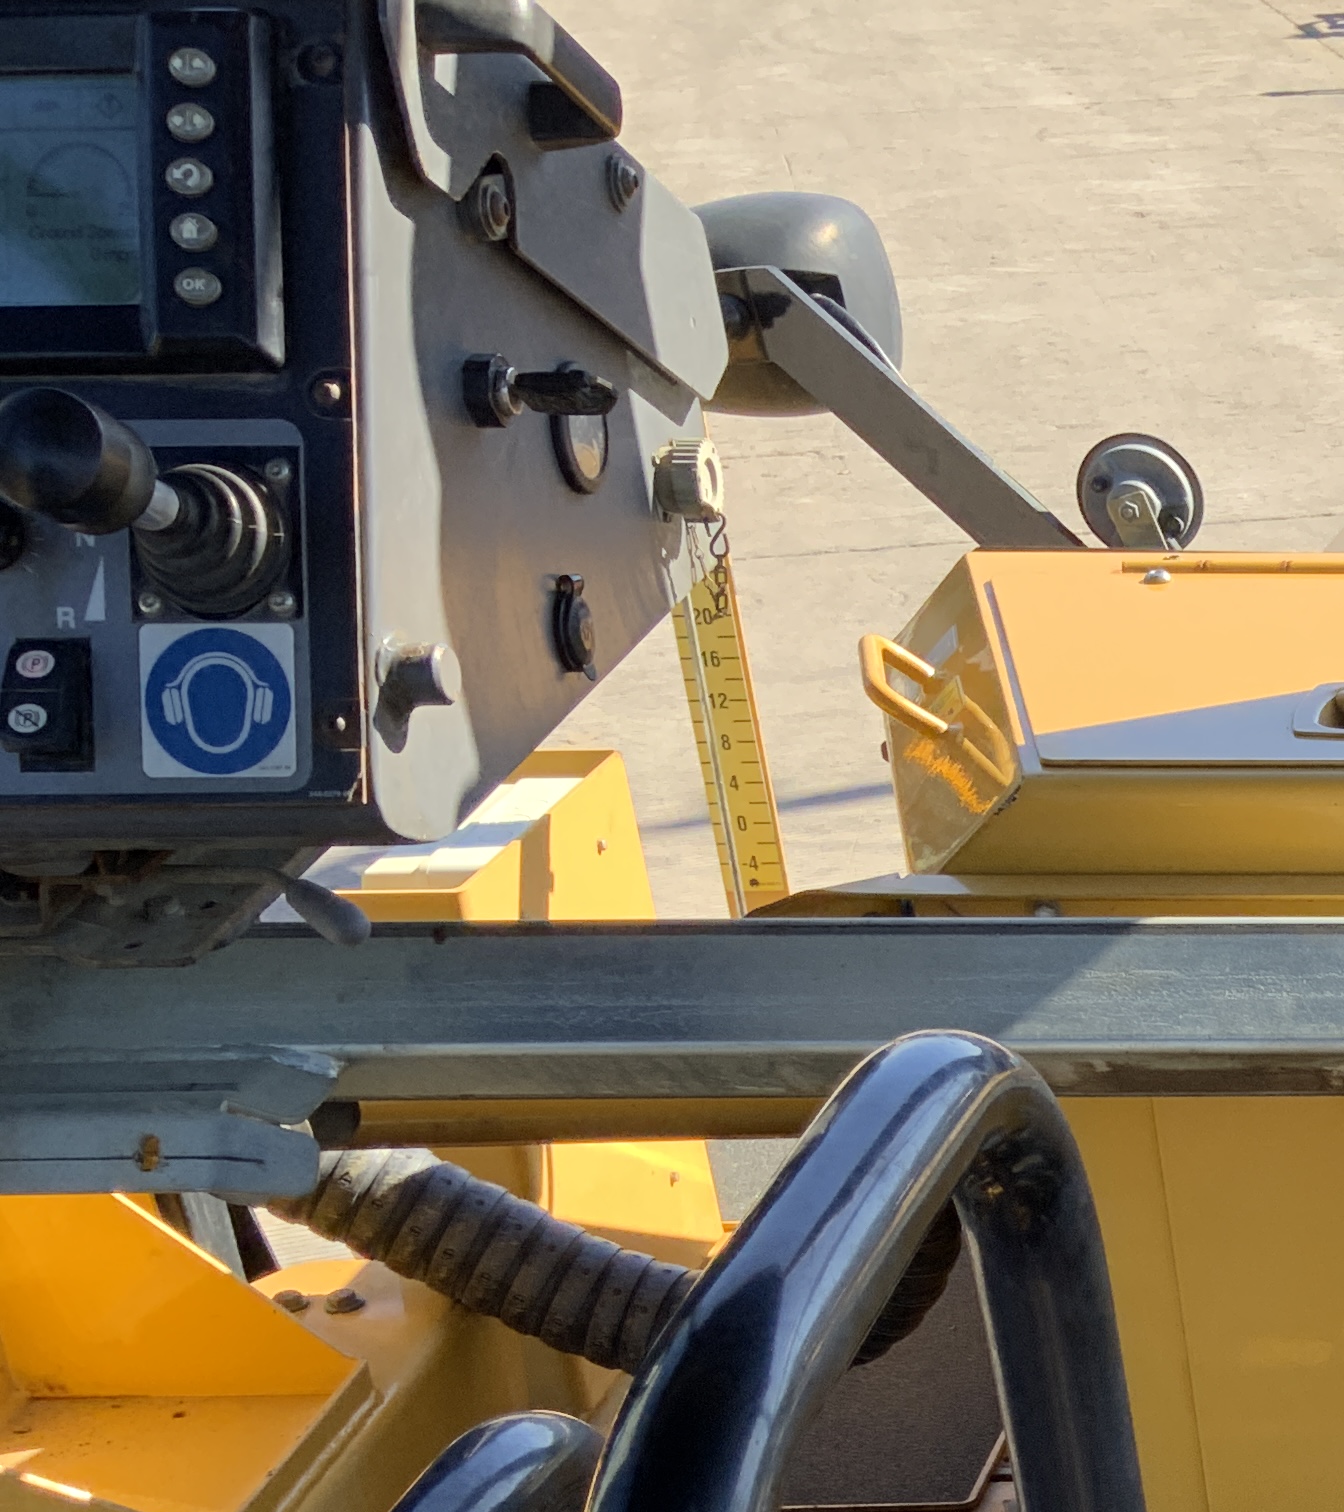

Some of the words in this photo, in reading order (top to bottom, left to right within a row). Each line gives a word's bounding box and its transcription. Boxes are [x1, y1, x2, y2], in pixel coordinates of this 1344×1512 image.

[182, 278, 206, 291] OK
[56, 606, 76, 629] R
[701, 650, 721, 668] 16
[708, 692, 729, 709] 12
[720, 734, 732, 751] 8
[729, 774, 740, 791] 4
[737, 815, 748, 831] 0
[742, 855, 759, 871] -4
